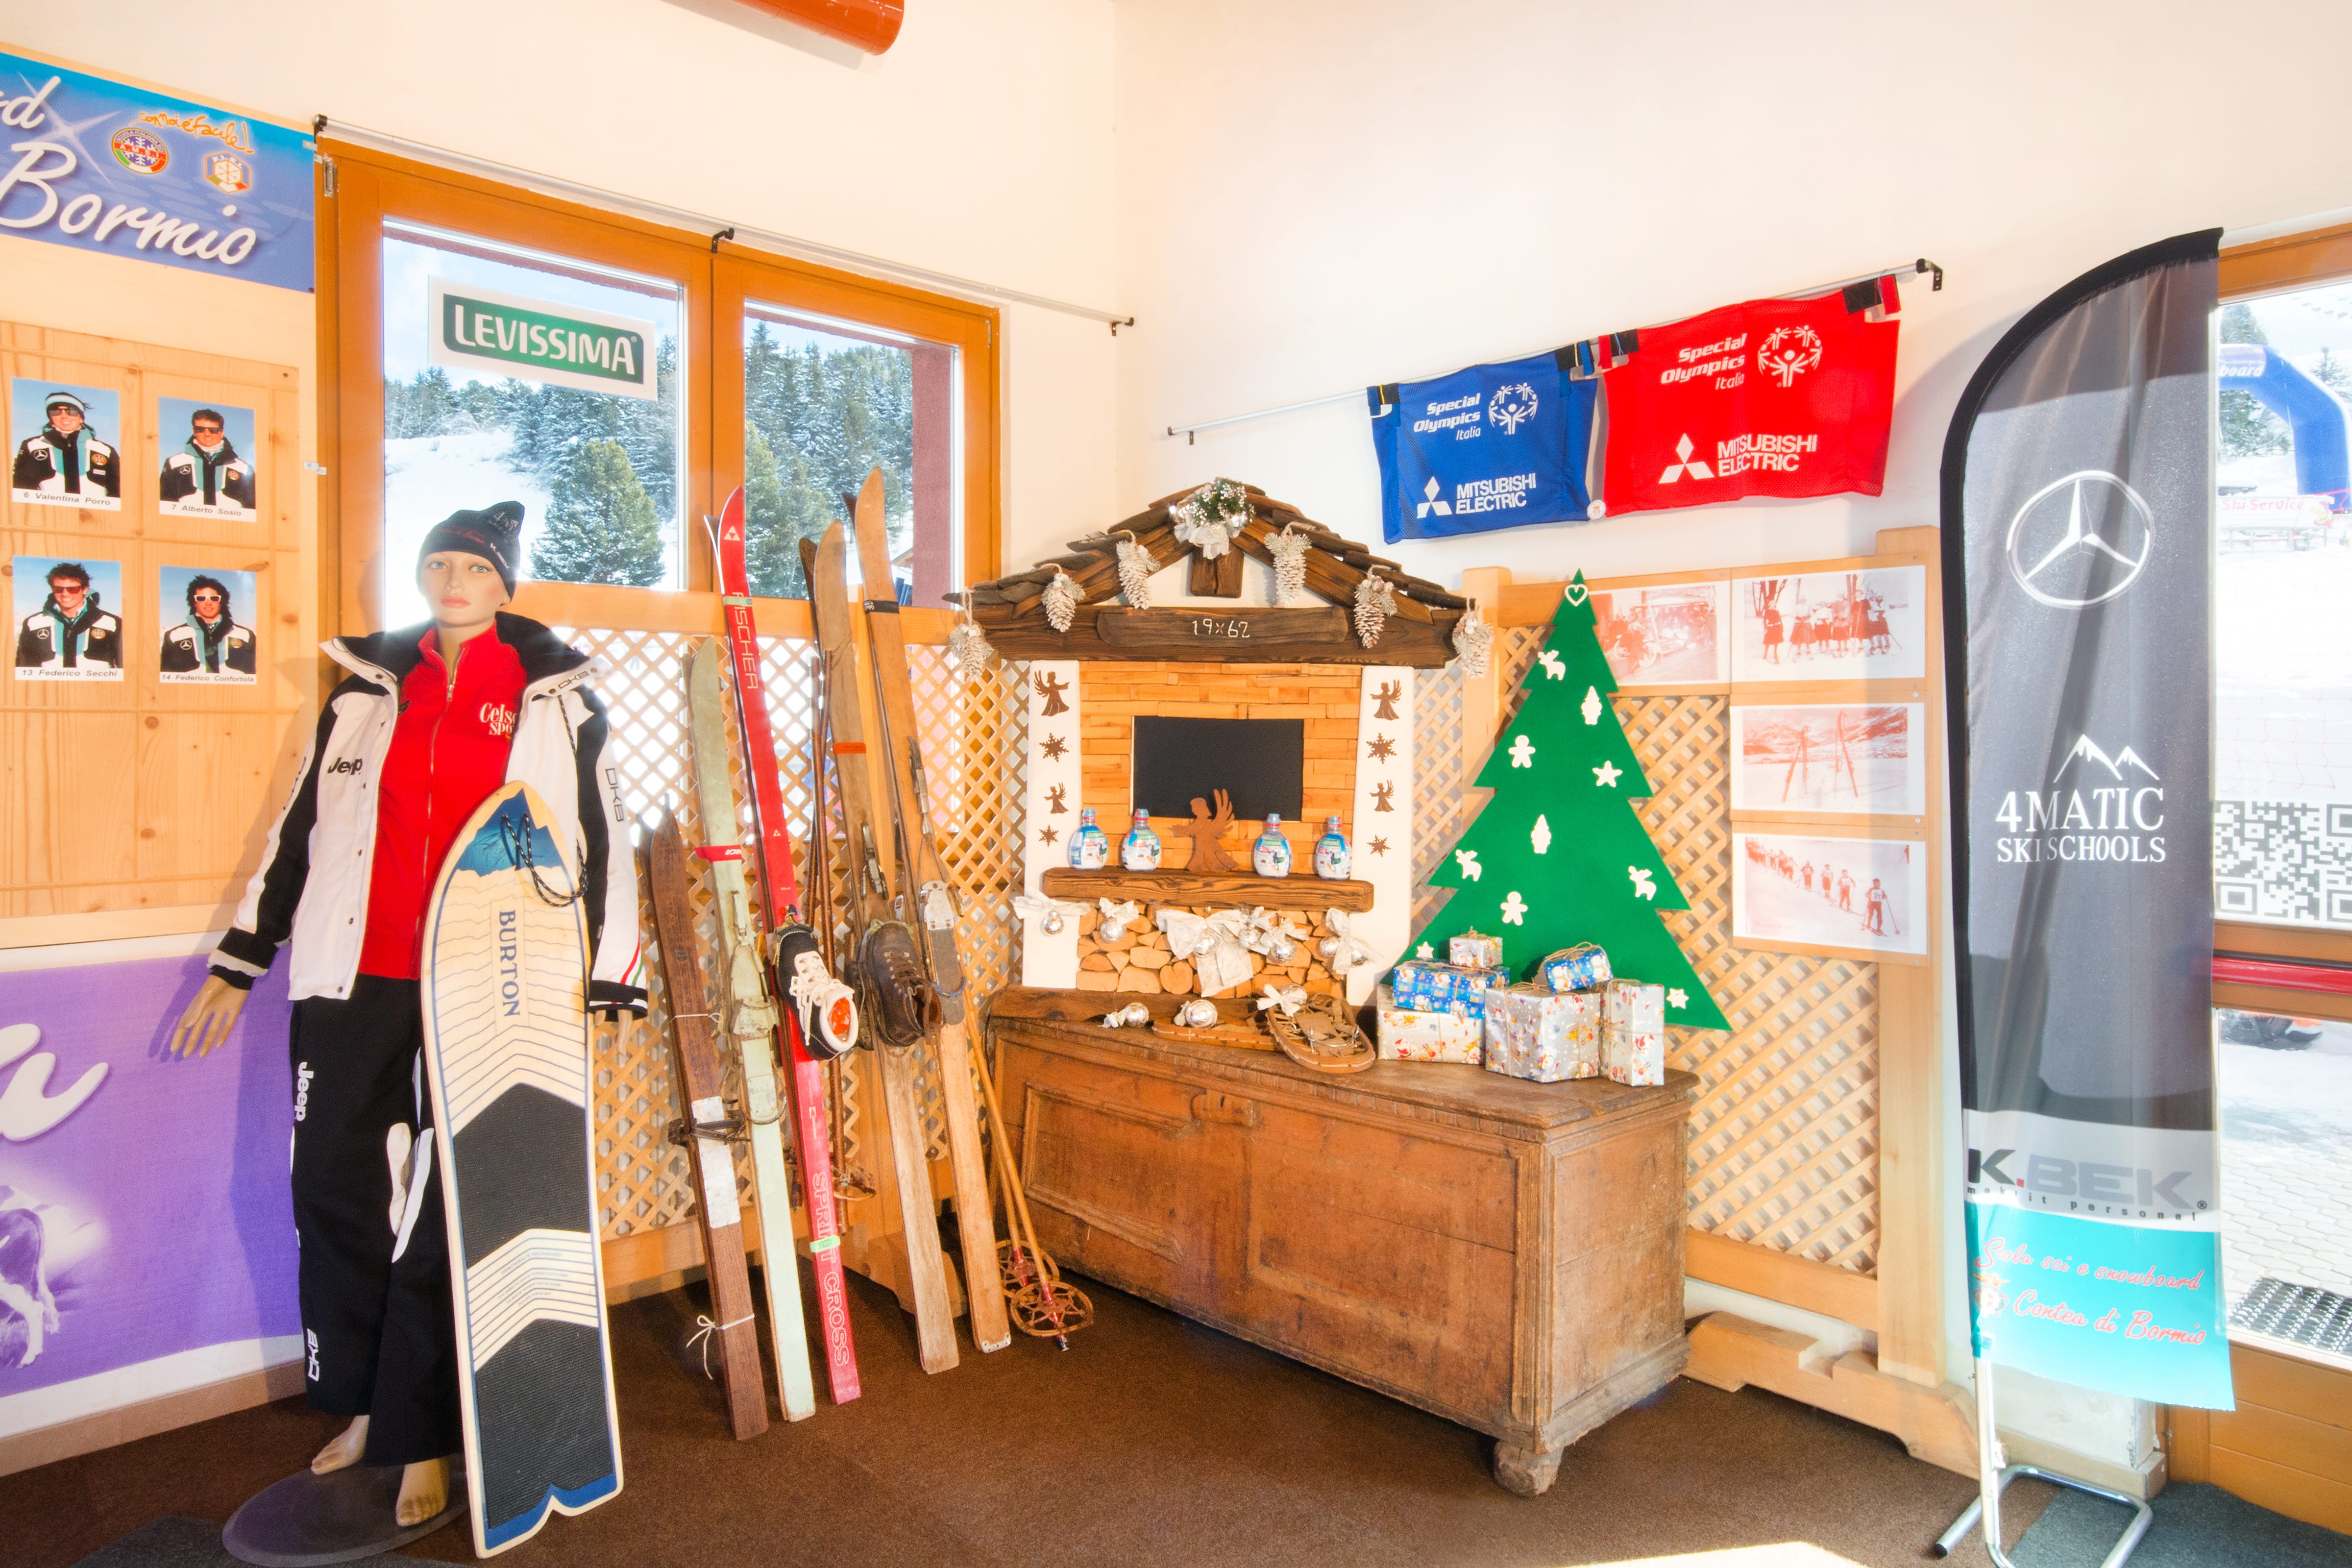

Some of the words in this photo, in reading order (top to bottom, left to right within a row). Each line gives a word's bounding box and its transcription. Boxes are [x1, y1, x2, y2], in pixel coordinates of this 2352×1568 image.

[0, 142, 256, 265] Bormio
[455, 304, 636, 375] LEVISSIMA
[1678, 333, 1747, 363] Special
[1660, 355, 1745, 384] Olympics
[1715, 372, 1745, 390] Italia
[1427, 392, 1481, 416] Special
[1413, 411, 1481, 433] Olympics
[1455, 426, 1481, 441] Italia
[1717, 434, 1818, 459] MITSUBISHI
[1718, 452, 1800, 477] ELECTRIC
[1457, 472, 1537, 499] MITSUBISHI
[35, 493, 79, 503] Valentina
[85, 497, 110, 506] Porro
[181, 505, 213, 514] Alberto
[1455, 491, 1527, 514] ELECTRIC
[2250, 498, 2304, 510] Service
[1996, 787, 2164, 833] 4MATIC
[1997, 837, 2042, 862] SKI
[2046, 834, 2166, 862] SCHOOLS
[499, 910, 520, 1017] BURTON
[295, 1061, 314, 1122] Jeep
[2070, 1200, 2196, 1222] personal
[2077, 1263, 2089, 1275] e
[2094, 1265, 2204, 1290] snowboard
[824, 1272, 850, 1367] CROSS
[2013, 1289, 2088, 1326] Contea
[2093, 1307, 2120, 1333] di
[2125, 1310, 2206, 1345] Bormio
